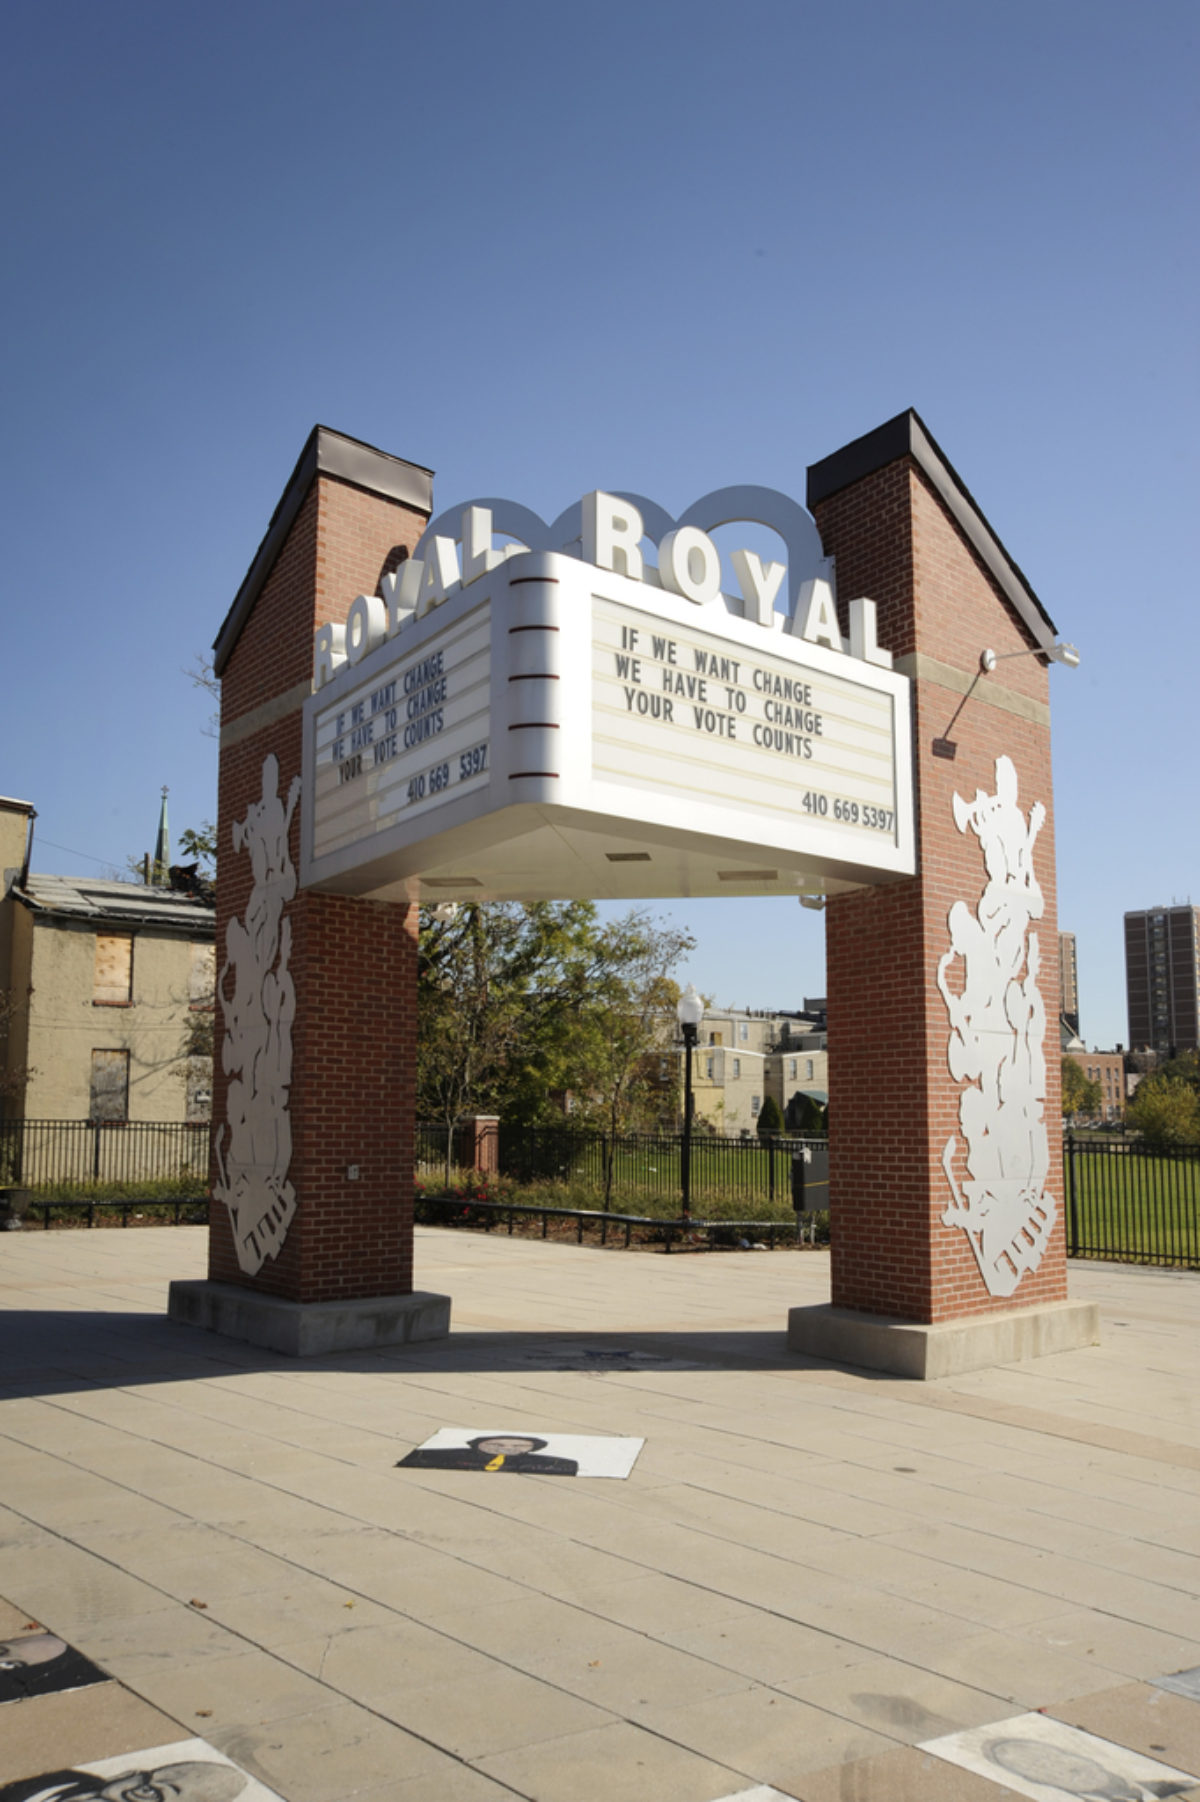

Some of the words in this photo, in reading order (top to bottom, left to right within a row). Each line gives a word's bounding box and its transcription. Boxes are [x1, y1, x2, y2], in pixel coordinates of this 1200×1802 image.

[314, 505, 505, 692] ROYAL
[581, 489, 893, 669] ROYAL
[336, 713, 345, 738] IF
[351, 702, 364, 725] WE
[371, 680, 396, 715] WANT
[404, 650, 444, 694] CHANGE
[614, 652, 641, 684] WE
[662, 667, 707, 703] HAVE
[725, 687, 747, 713] TO
[764, 699, 823, 736] CHANGE
[622, 625, 639, 651] IF
[651, 634, 677, 665] WE
[693, 648, 741, 684] WANT
[752, 668, 812, 707] CHANGE
[332, 739, 344, 763] WE
[351, 721, 373, 750] HAVE
[384, 708, 397, 732] TO
[407, 677, 447, 720] CHANGE
[338, 754, 363, 785] YOUR
[373, 734, 397, 766] VOTE
[404, 707, 444, 748] COUNTS
[623, 685, 674, 722] YOUR
[693, 705, 736, 739] VOTE
[752, 723, 813, 760] COUNTS
[407, 775, 425, 803] 410
[429, 763, 449, 793] 669
[459, 743, 488, 781] 5397
[802, 791, 828, 816] 410
[833, 798, 859, 824] 669
[862, 805, 894, 831] 5397
